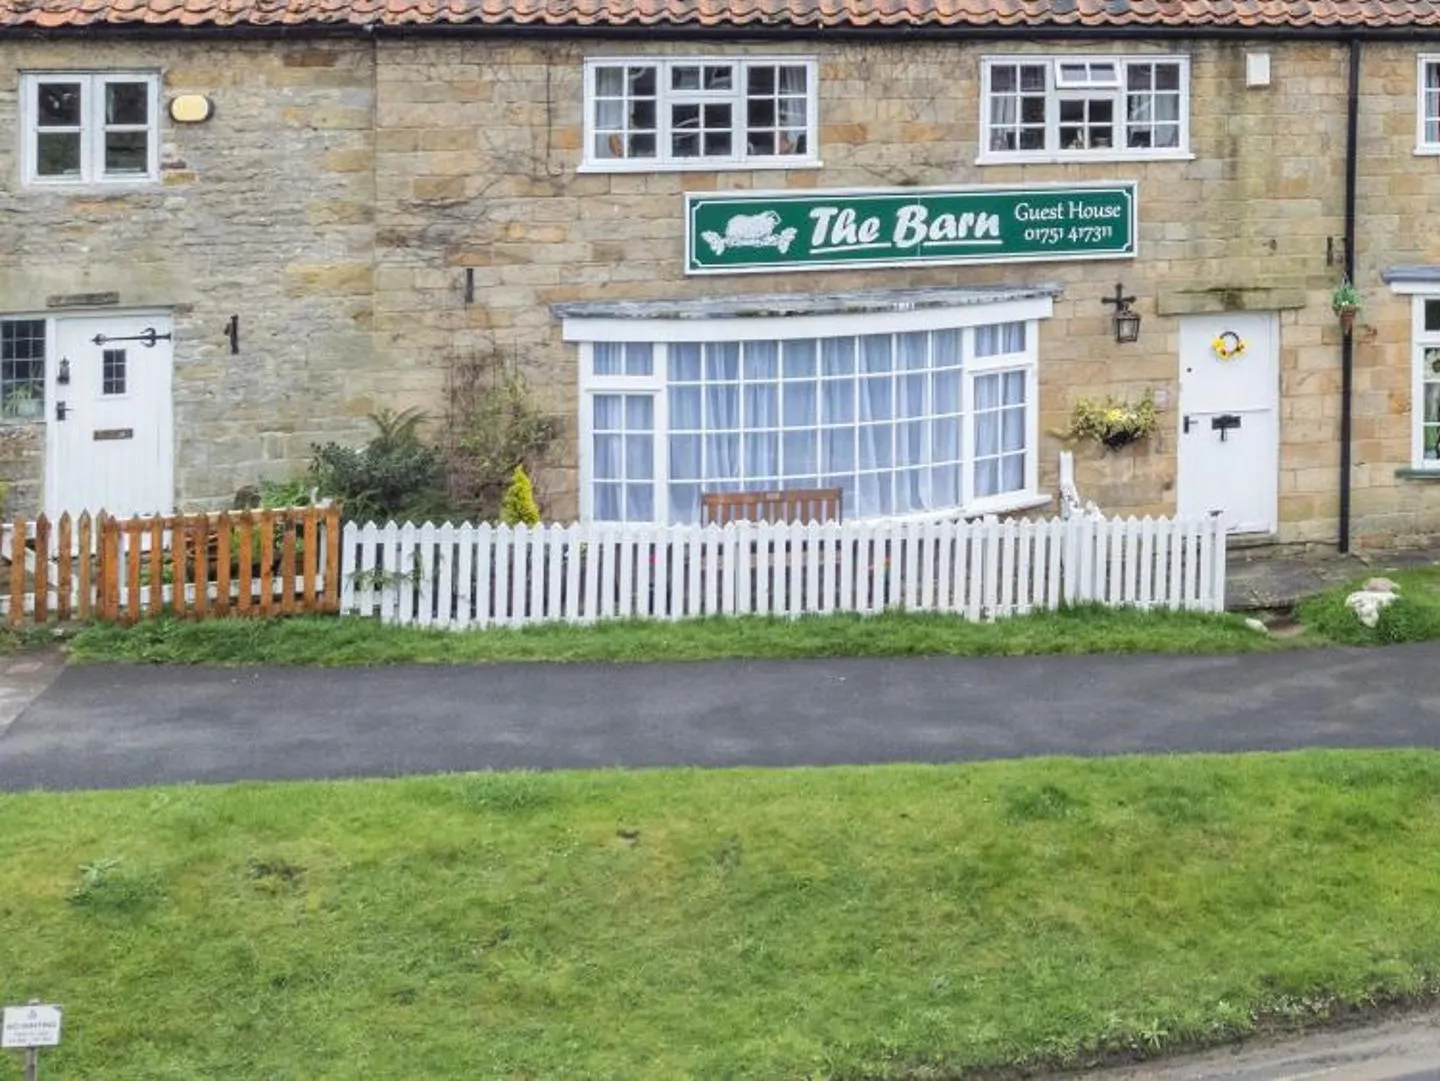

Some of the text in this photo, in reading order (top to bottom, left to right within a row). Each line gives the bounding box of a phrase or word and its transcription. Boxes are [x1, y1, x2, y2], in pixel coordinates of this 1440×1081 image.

[1014, 200, 1121, 221] Guest House
[809, 204, 1000, 248] The Barn
[1024, 225, 1113, 244] 01751 417311
